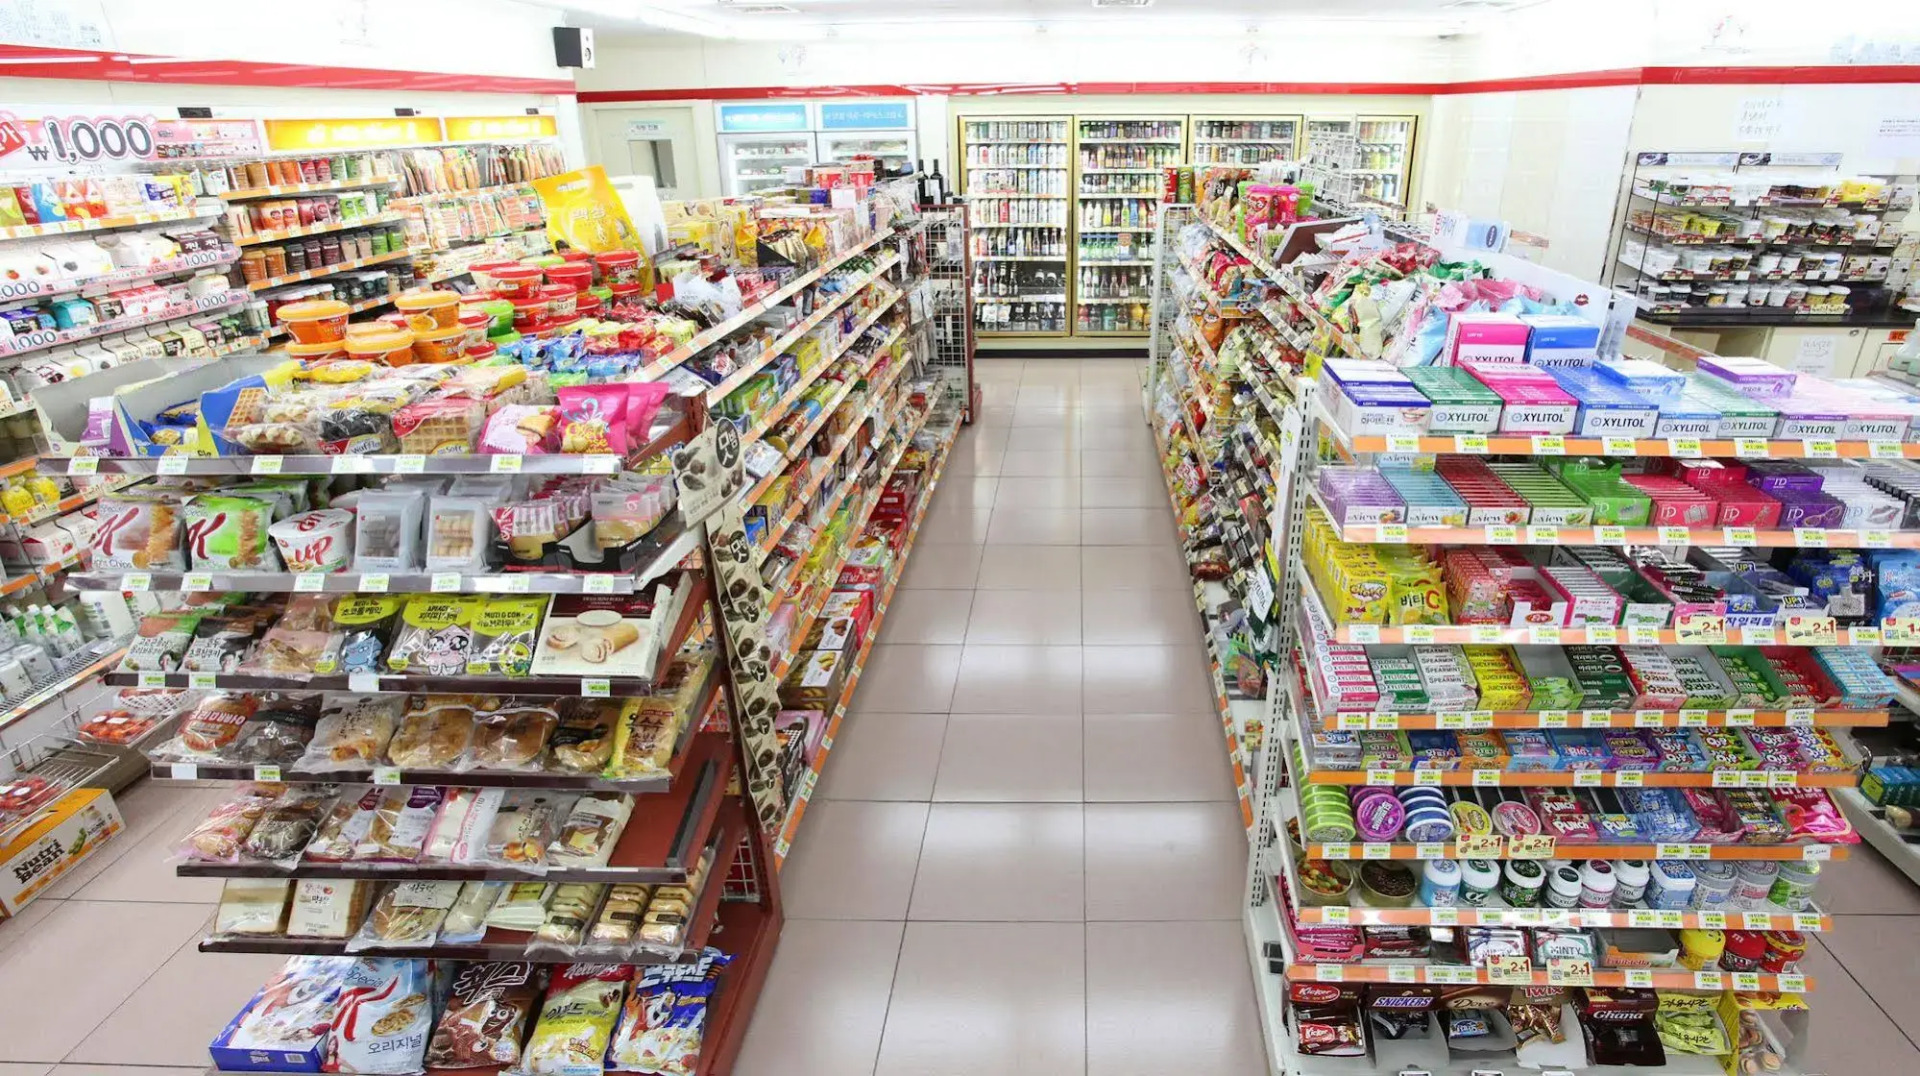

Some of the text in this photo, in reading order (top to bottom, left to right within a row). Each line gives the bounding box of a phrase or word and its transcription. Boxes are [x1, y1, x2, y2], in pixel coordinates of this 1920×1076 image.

[1546, 359, 1585, 368] XYLITOL
[1446, 412, 1490, 422] XYLITOL
[1522, 412, 1565, 423] XYLITOL
[1602, 418, 1645, 428] XYLITOL
[1672, 423, 1711, 433] XYLITOL
[1731, 422, 1768, 431] XYLITOL
[1797, 425, 1836, 434] XYLITOL
[1857, 425, 1898, 434] XYLITOL
[93, 507, 139, 556] K
[188, 512, 227, 560] K
[1400, 590, 1440, 610] 비타C
[1702, 619, 1725, 633] 2+1
[1725, 616, 1774, 627] 자일리톨
[1813, 619, 1835, 634] 2+1
[1480, 836, 1502, 849] 2+1
[1533, 836, 1555, 849] 2+1
[12, 839, 62, 875] Nutri
[18, 848, 65, 884] Bean
[1550, 945, 1581, 955] MINTY
[1510, 962, 1531, 975] 2+1
[1570, 962, 1592, 977] 2+1
[1299, 988, 1333, 997] Kicker
[1376, 997, 1431, 1007] SNICKERS
[1453, 998, 1495, 1009] Dove
[1660, 998, 1709, 1008] 자유시간
[332, 976, 399, 1042] K
[1593, 1010, 1645, 1020] Ghana
[368, 1033, 423, 1055] 오리지널
